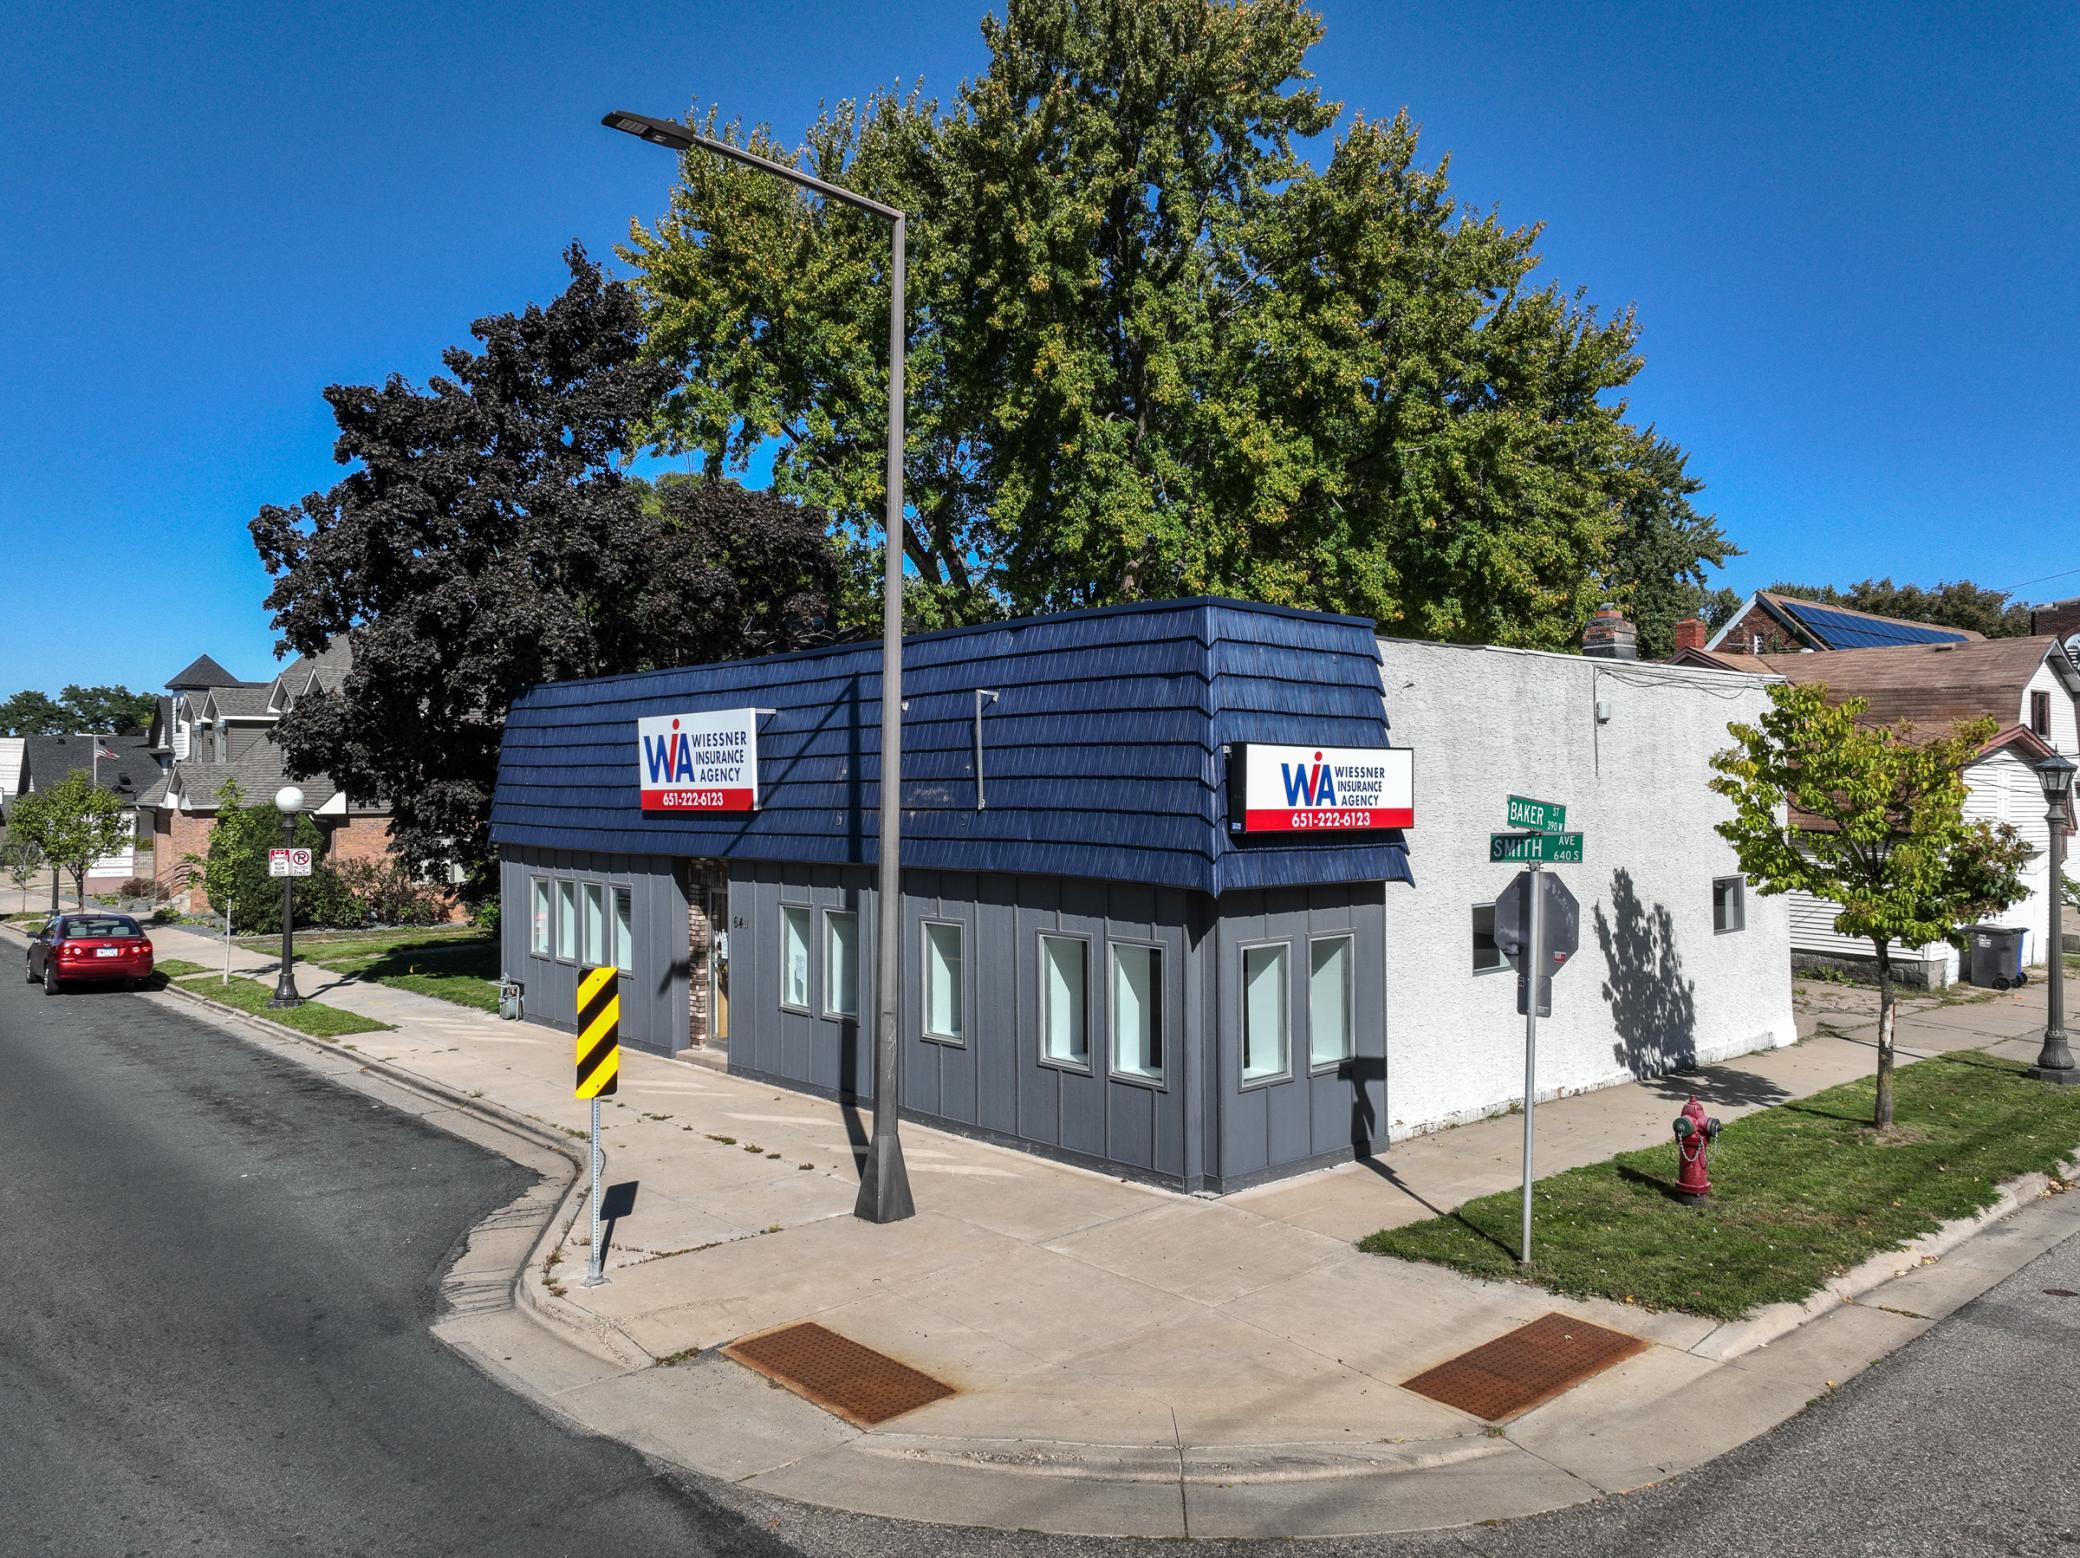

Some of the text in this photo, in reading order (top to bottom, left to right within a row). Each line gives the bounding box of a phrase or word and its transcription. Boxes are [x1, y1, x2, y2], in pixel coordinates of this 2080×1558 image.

[691, 731, 747, 748] WIESSNER
[695, 749, 744, 765] INSURANCE
[700, 767, 740, 782] AGENCY
[1334, 766, 1385, 779] WIESSNER
[1337, 781, 1382, 793] INSURANCE
[663, 791, 724, 806] 651-222-6123
[1341, 795, 1379, 807] AGENCY
[1291, 811, 1371, 828] 651-222-6123
[1510, 801, 1560, 826] BAKER ST
[1546, 820, 1558, 831] 390
[1493, 835, 1575, 858] SMITH AVE
[1553, 850, 1579, 860] 640 S
